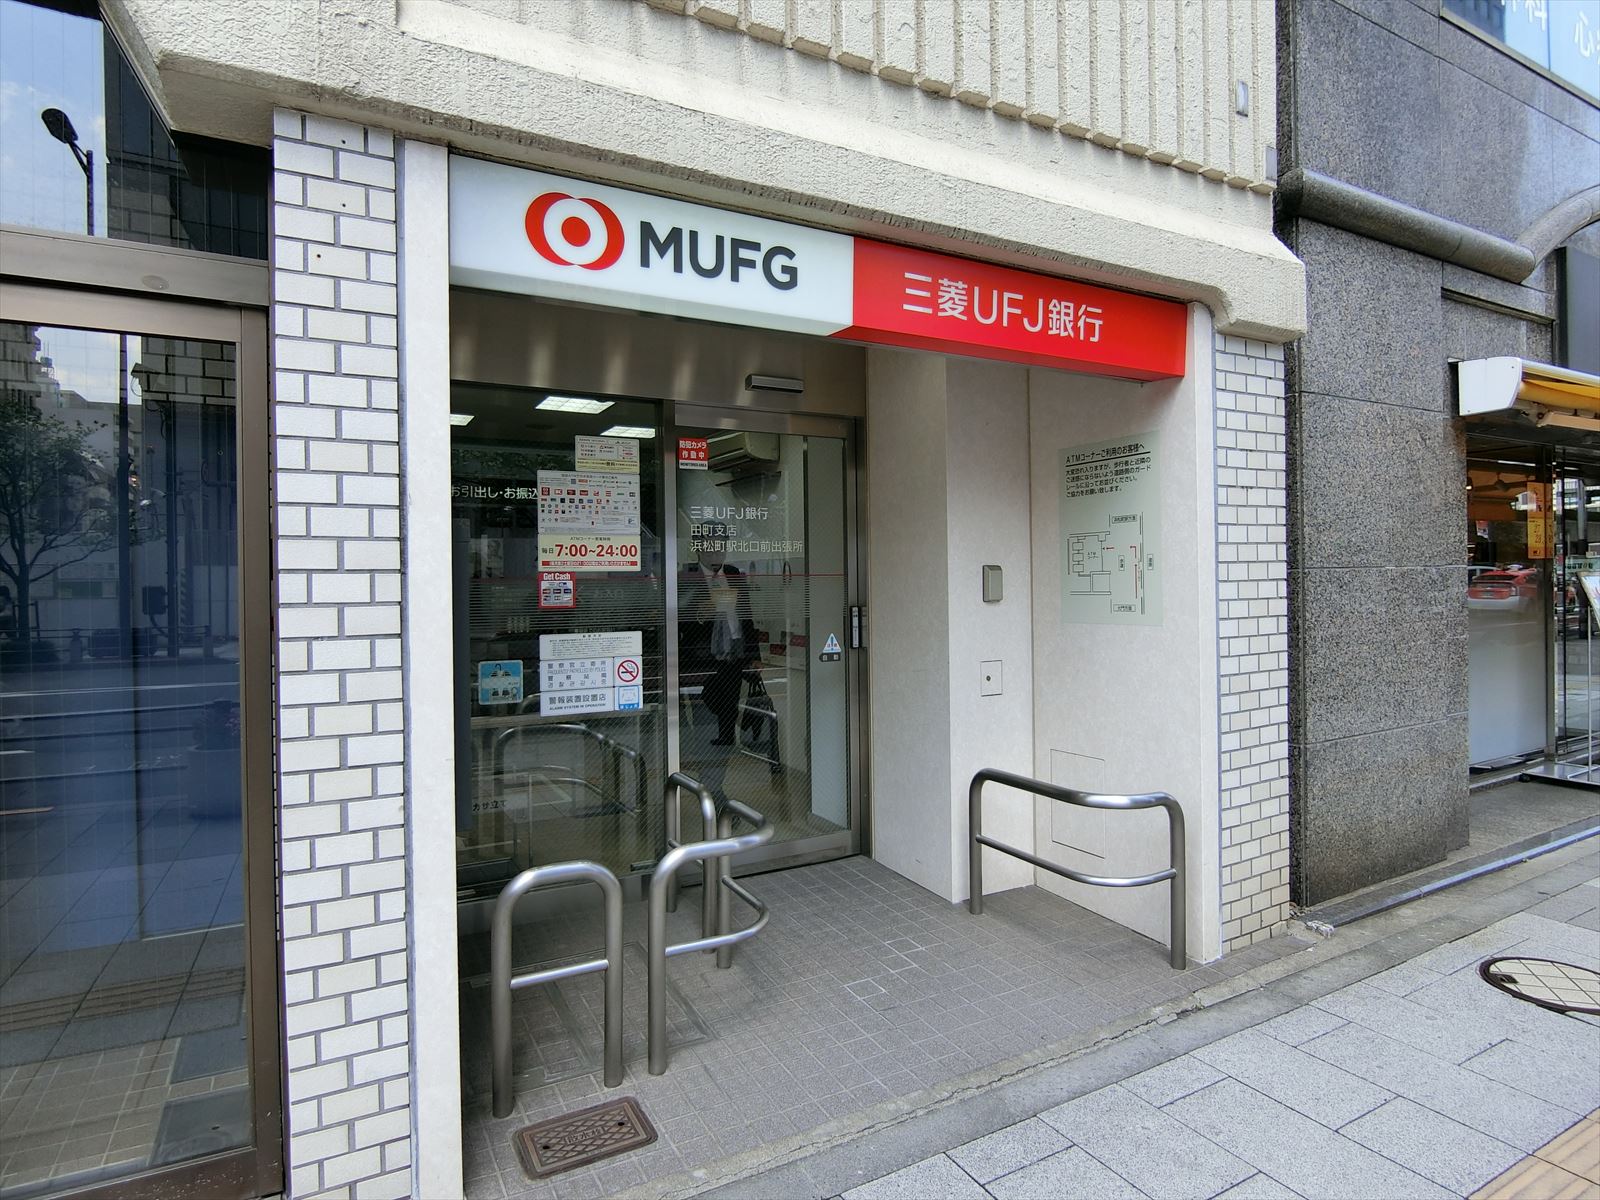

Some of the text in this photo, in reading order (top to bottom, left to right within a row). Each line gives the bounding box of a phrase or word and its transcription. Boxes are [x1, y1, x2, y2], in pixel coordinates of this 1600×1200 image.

[640, 220, 798, 291] MUFG
[902, 271, 1104, 343] 三菱UFJ銀行
[679, 440, 707, 449] 防犯カメラ
[682, 450, 705, 459] 作動中
[1065, 443, 1145, 464] ATMコーナーご利用のお客様へ
[690, 506, 769, 520] 三菱UFJ銀行
[690, 524, 737, 537] 田町支店
[690, 539, 803, 553] 浜松町駅北口前出張所
[543, 572, 571, 581] Get Cash
[549, 693, 607, 704] 警報装置設置店
